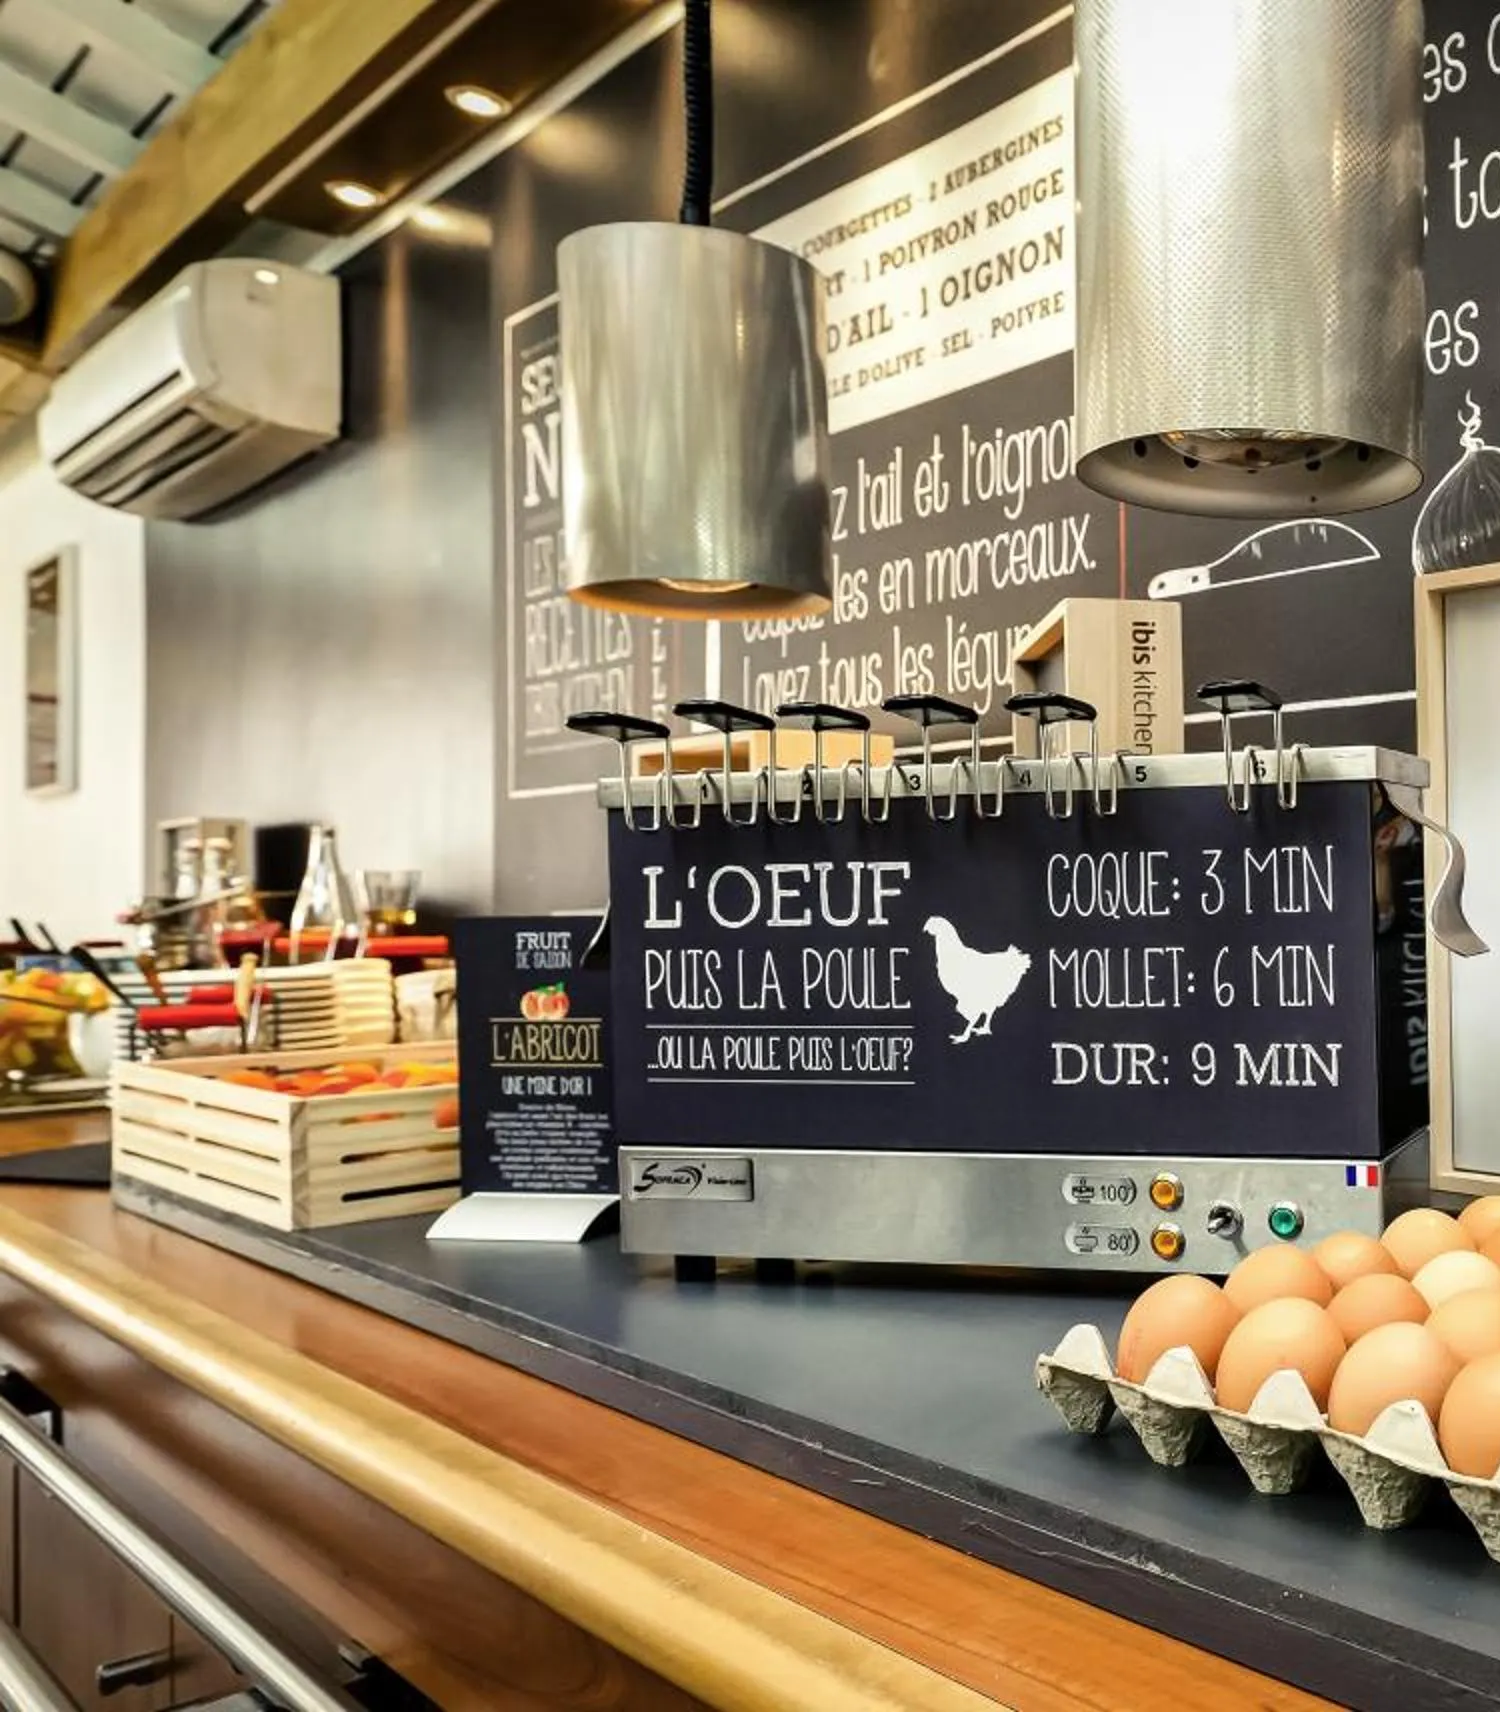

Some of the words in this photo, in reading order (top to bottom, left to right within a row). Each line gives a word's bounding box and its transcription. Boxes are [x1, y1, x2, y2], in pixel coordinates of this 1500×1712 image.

[1424, 31, 1467, 102] es
[944, 115, 1064, 196] AUBERGINES
[879, 210, 977, 276] POIVRON
[986, 168, 1065, 229] ROUGE
[941, 226, 1066, 308] OIGNON
[941, 328, 973, 358] SEL
[991, 291, 1064, 339] POIVRE
[1424, 300, 1480, 375] es
[857, 446, 903, 535] l'ail
[914, 434, 949, 517] et
[832, 553, 869, 625] les
[878, 556, 915, 615] en
[925, 513, 1097, 604] morceaux.
[818, 641, 883, 707] tous
[893, 625, 934, 696] les
[1132, 621, 1157, 665] ibis
[1133, 671, 1158, 755] kitchen
[909, 774, 920, 791] 3
[1018, 770, 1031, 787] 4
[1135, 766, 1147, 782] 5
[642, 861, 911, 929] L'OEUF
[1047, 851, 1181, 919] COQUE:
[1201, 850, 1225, 915] 3
[1244, 845, 1334, 914] MIN
[515, 931, 571, 950] FRUIT
[645, 949, 723, 1010] PUIS
[738, 949, 786, 1010] LA
[802, 948, 912, 1009] POULE
[1049, 947, 1196, 1008] MOLLET:
[1213, 946, 1236, 1007] 6
[1252, 944, 1335, 1007] MIN
[492, 1023, 600, 1061] L'ABRICOT
[689, 1036, 716, 1069] LA
[723, 1036, 781, 1071] POULE
[788, 1036, 833, 1071] PUIS
[841, 1036, 913, 1071] L'OEUF?
[1051, 1043, 1170, 1085] DUR:
[1191, 1042, 1217, 1086] 9
[1233, 1043, 1343, 1086] MIN
